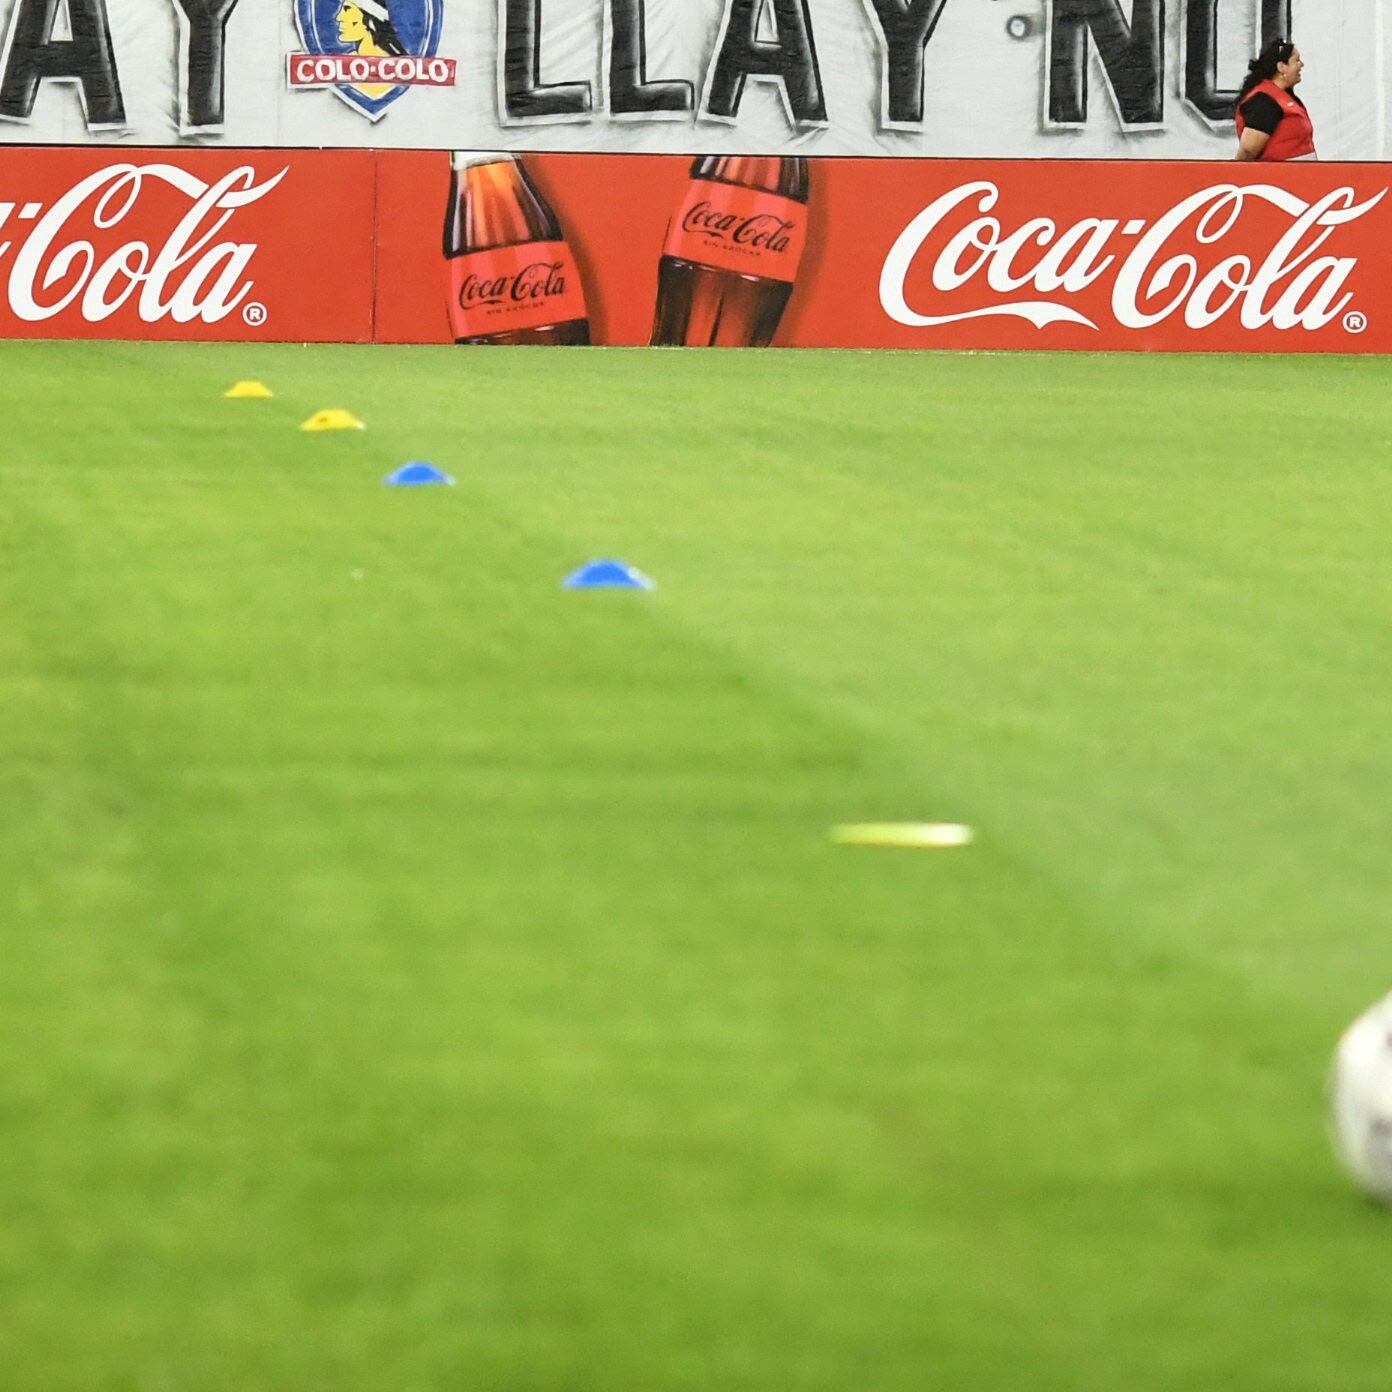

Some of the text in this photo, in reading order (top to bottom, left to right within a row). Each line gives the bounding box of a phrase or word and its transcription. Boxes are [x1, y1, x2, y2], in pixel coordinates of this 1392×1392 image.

[681, 200, 791, 254] Coca-Cola
[879, 180, 1389, 331] Coca-Cola
[458, 261, 567, 311] Coca-Cola
